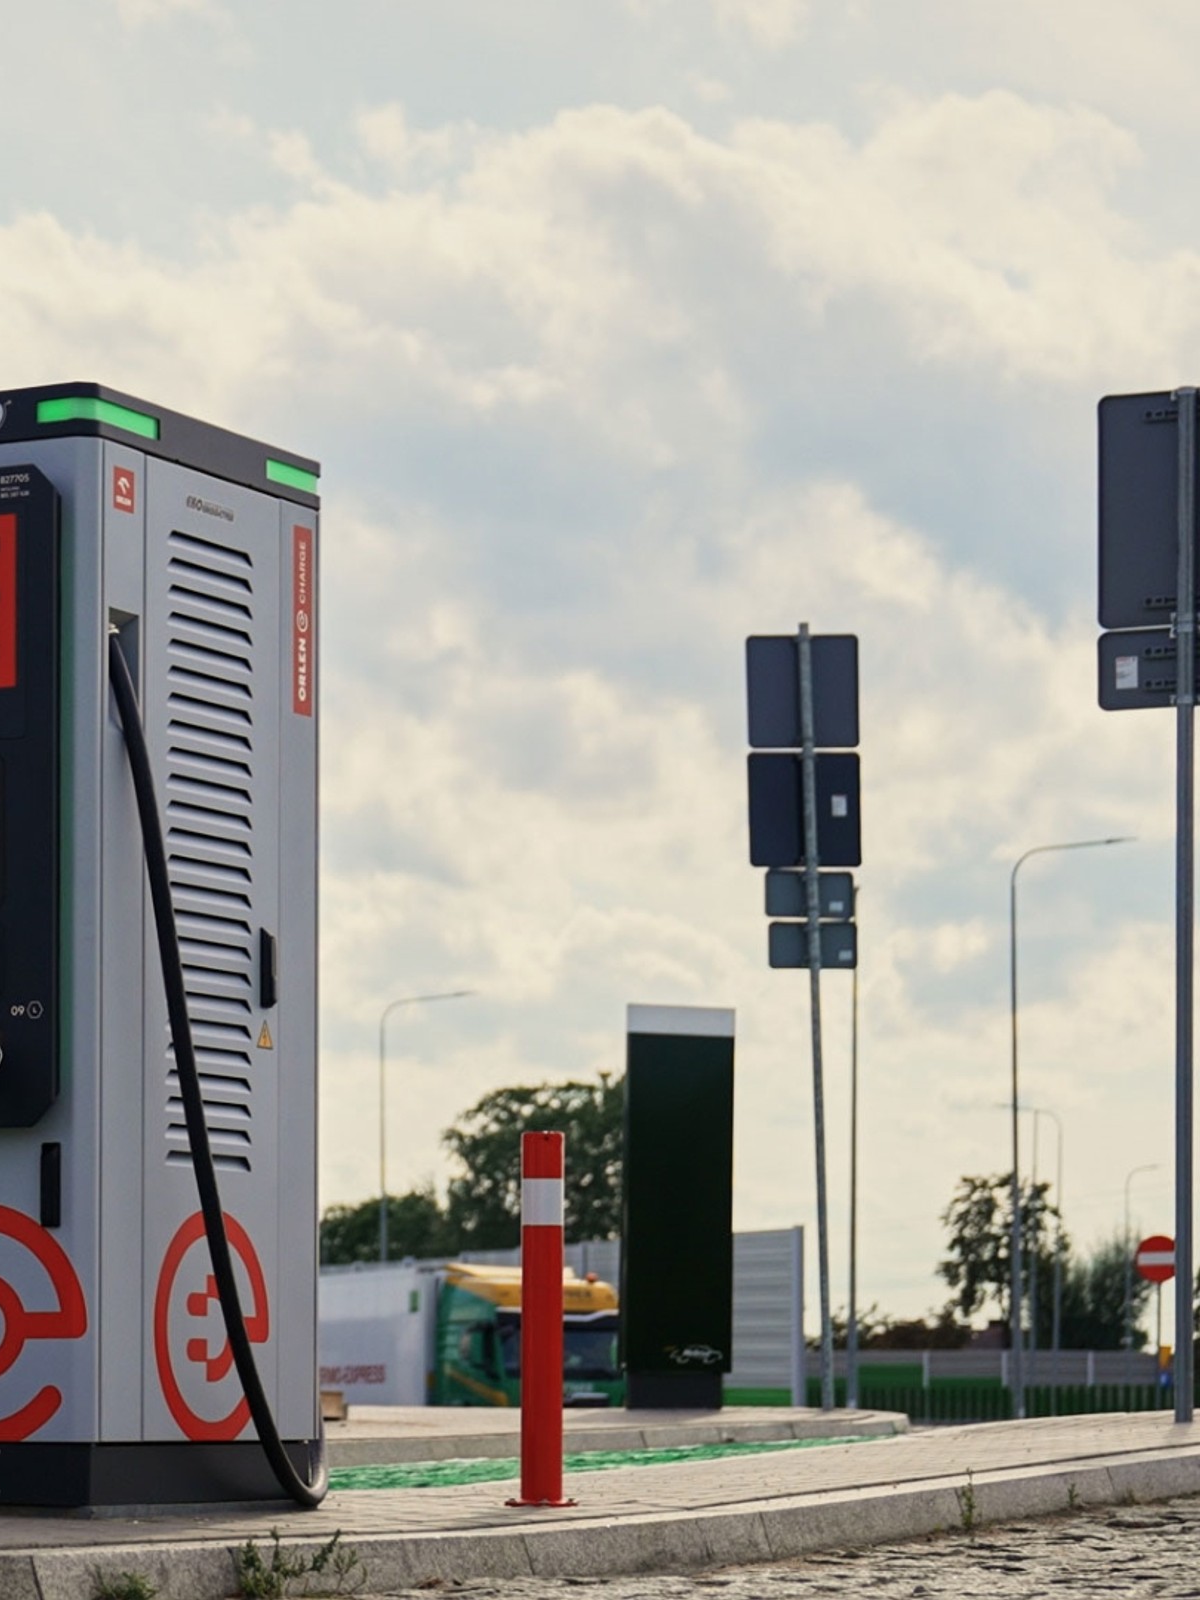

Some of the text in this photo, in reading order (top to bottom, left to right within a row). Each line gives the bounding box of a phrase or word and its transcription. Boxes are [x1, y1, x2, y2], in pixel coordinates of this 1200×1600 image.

[297, 540, 307, 702] ORLEN CHARGE
[10, 1004, 25, 1017] 09
